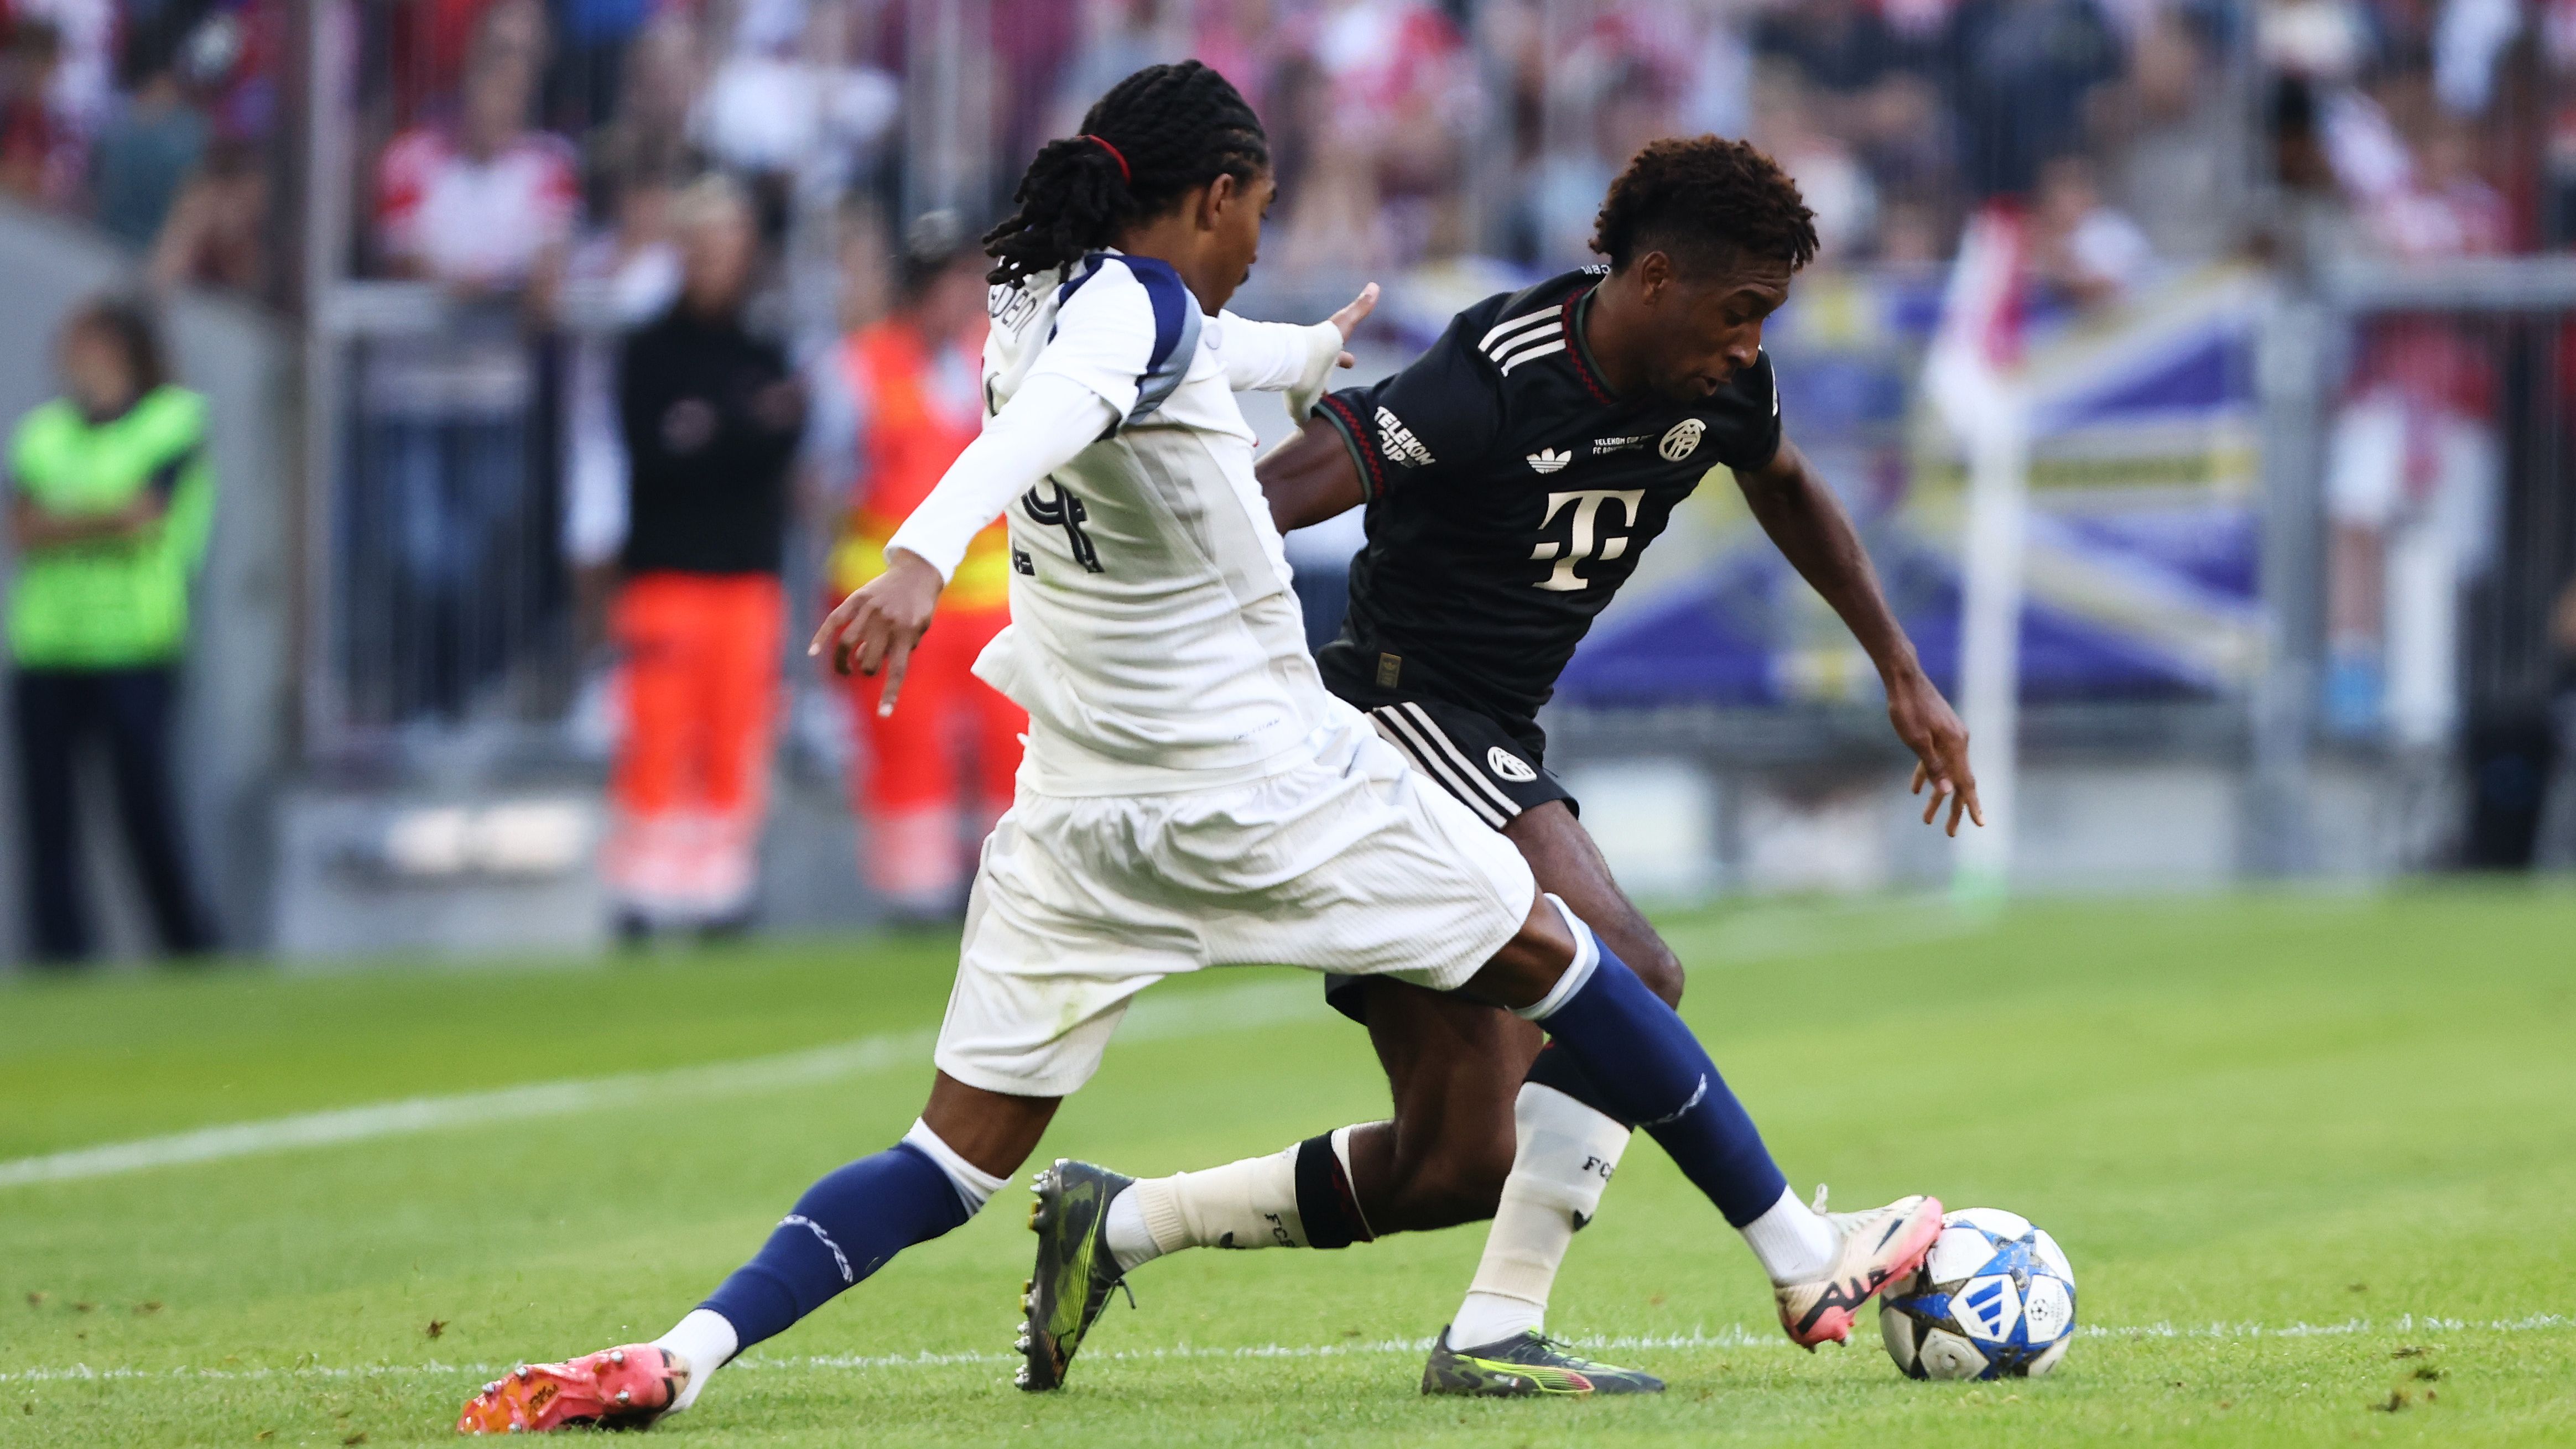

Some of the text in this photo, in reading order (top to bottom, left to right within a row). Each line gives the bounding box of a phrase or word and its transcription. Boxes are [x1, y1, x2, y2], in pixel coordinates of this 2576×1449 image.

[1373, 405, 1437, 465] TELEKOM
[1377, 429, 1407, 462] CUP
[1594, 437, 1626, 446] TELEKOM
[1530, 488, 1645, 592] T
